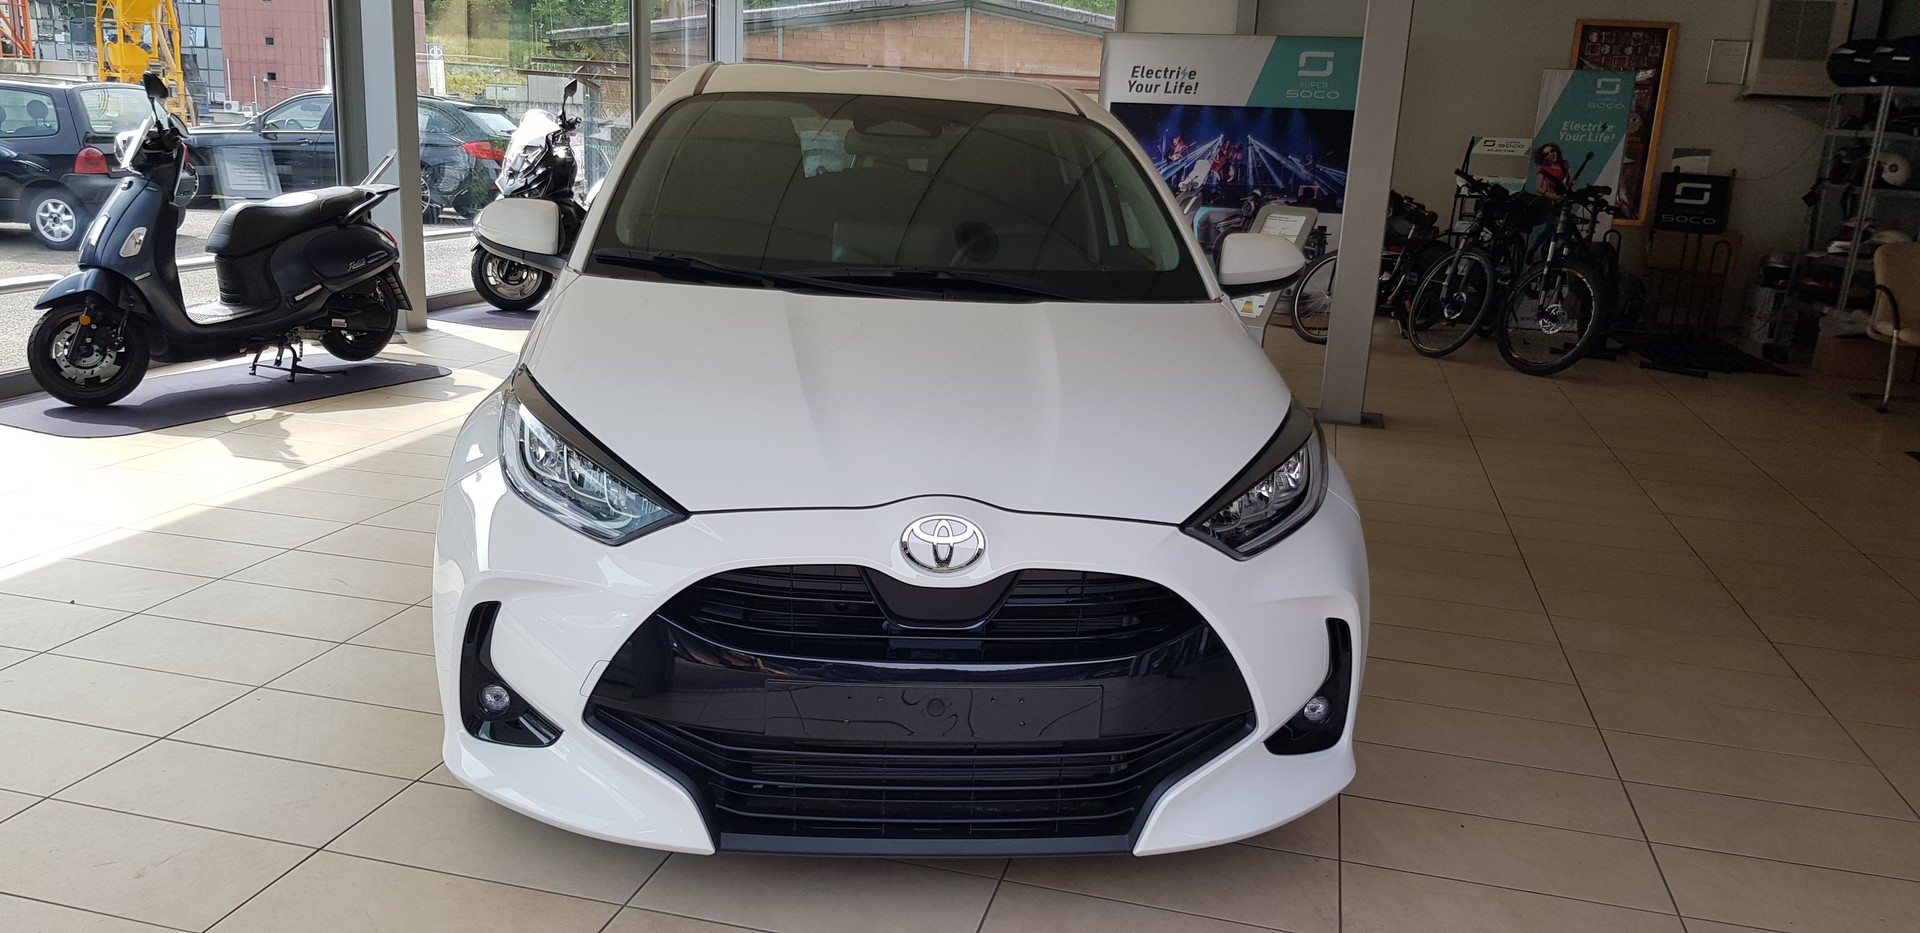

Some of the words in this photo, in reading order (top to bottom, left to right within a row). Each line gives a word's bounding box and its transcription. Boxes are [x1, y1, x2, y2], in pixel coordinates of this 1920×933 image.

[1128, 80, 1161, 93] Your
[1164, 81, 1199, 95] Life!
[1286, 89, 1340, 100] SOCO
[1559, 131, 1586, 142] Your
[1587, 132, 1616, 143] Life!
[1661, 214, 1717, 226] SOCO
